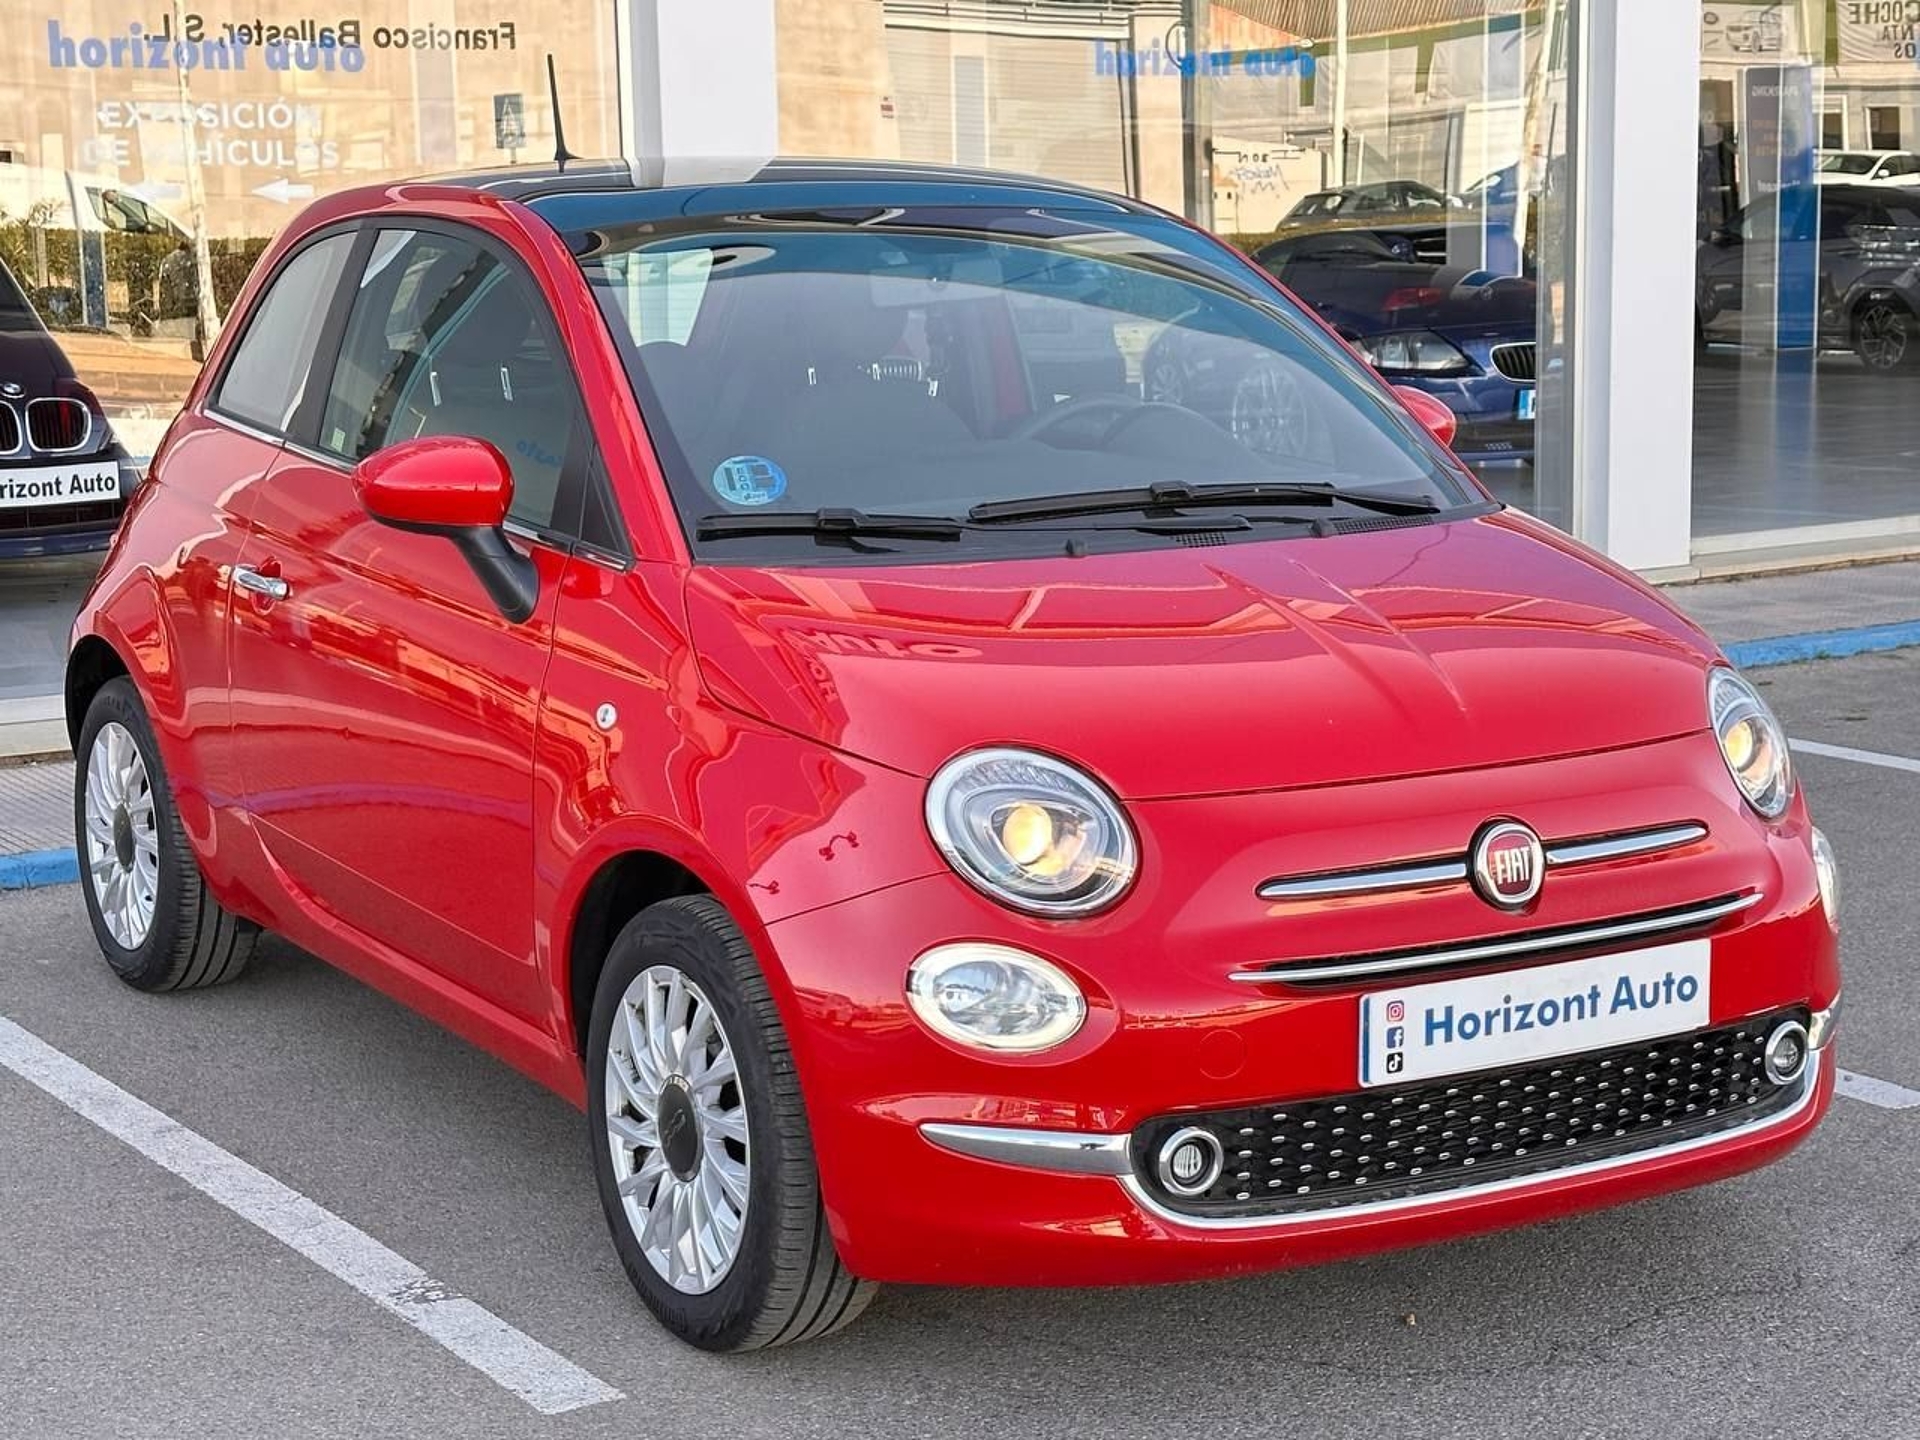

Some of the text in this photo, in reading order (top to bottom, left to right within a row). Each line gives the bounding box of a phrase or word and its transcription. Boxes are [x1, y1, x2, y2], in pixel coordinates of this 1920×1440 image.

[48, 20, 365, 72] horizont auto
[1095, 37, 1316, 78] horizont auto
[0, 473, 116, 499] rizont Auto
[1494, 846, 1530, 885] FIAT
[1424, 972, 1698, 1047] Horizont Auto
